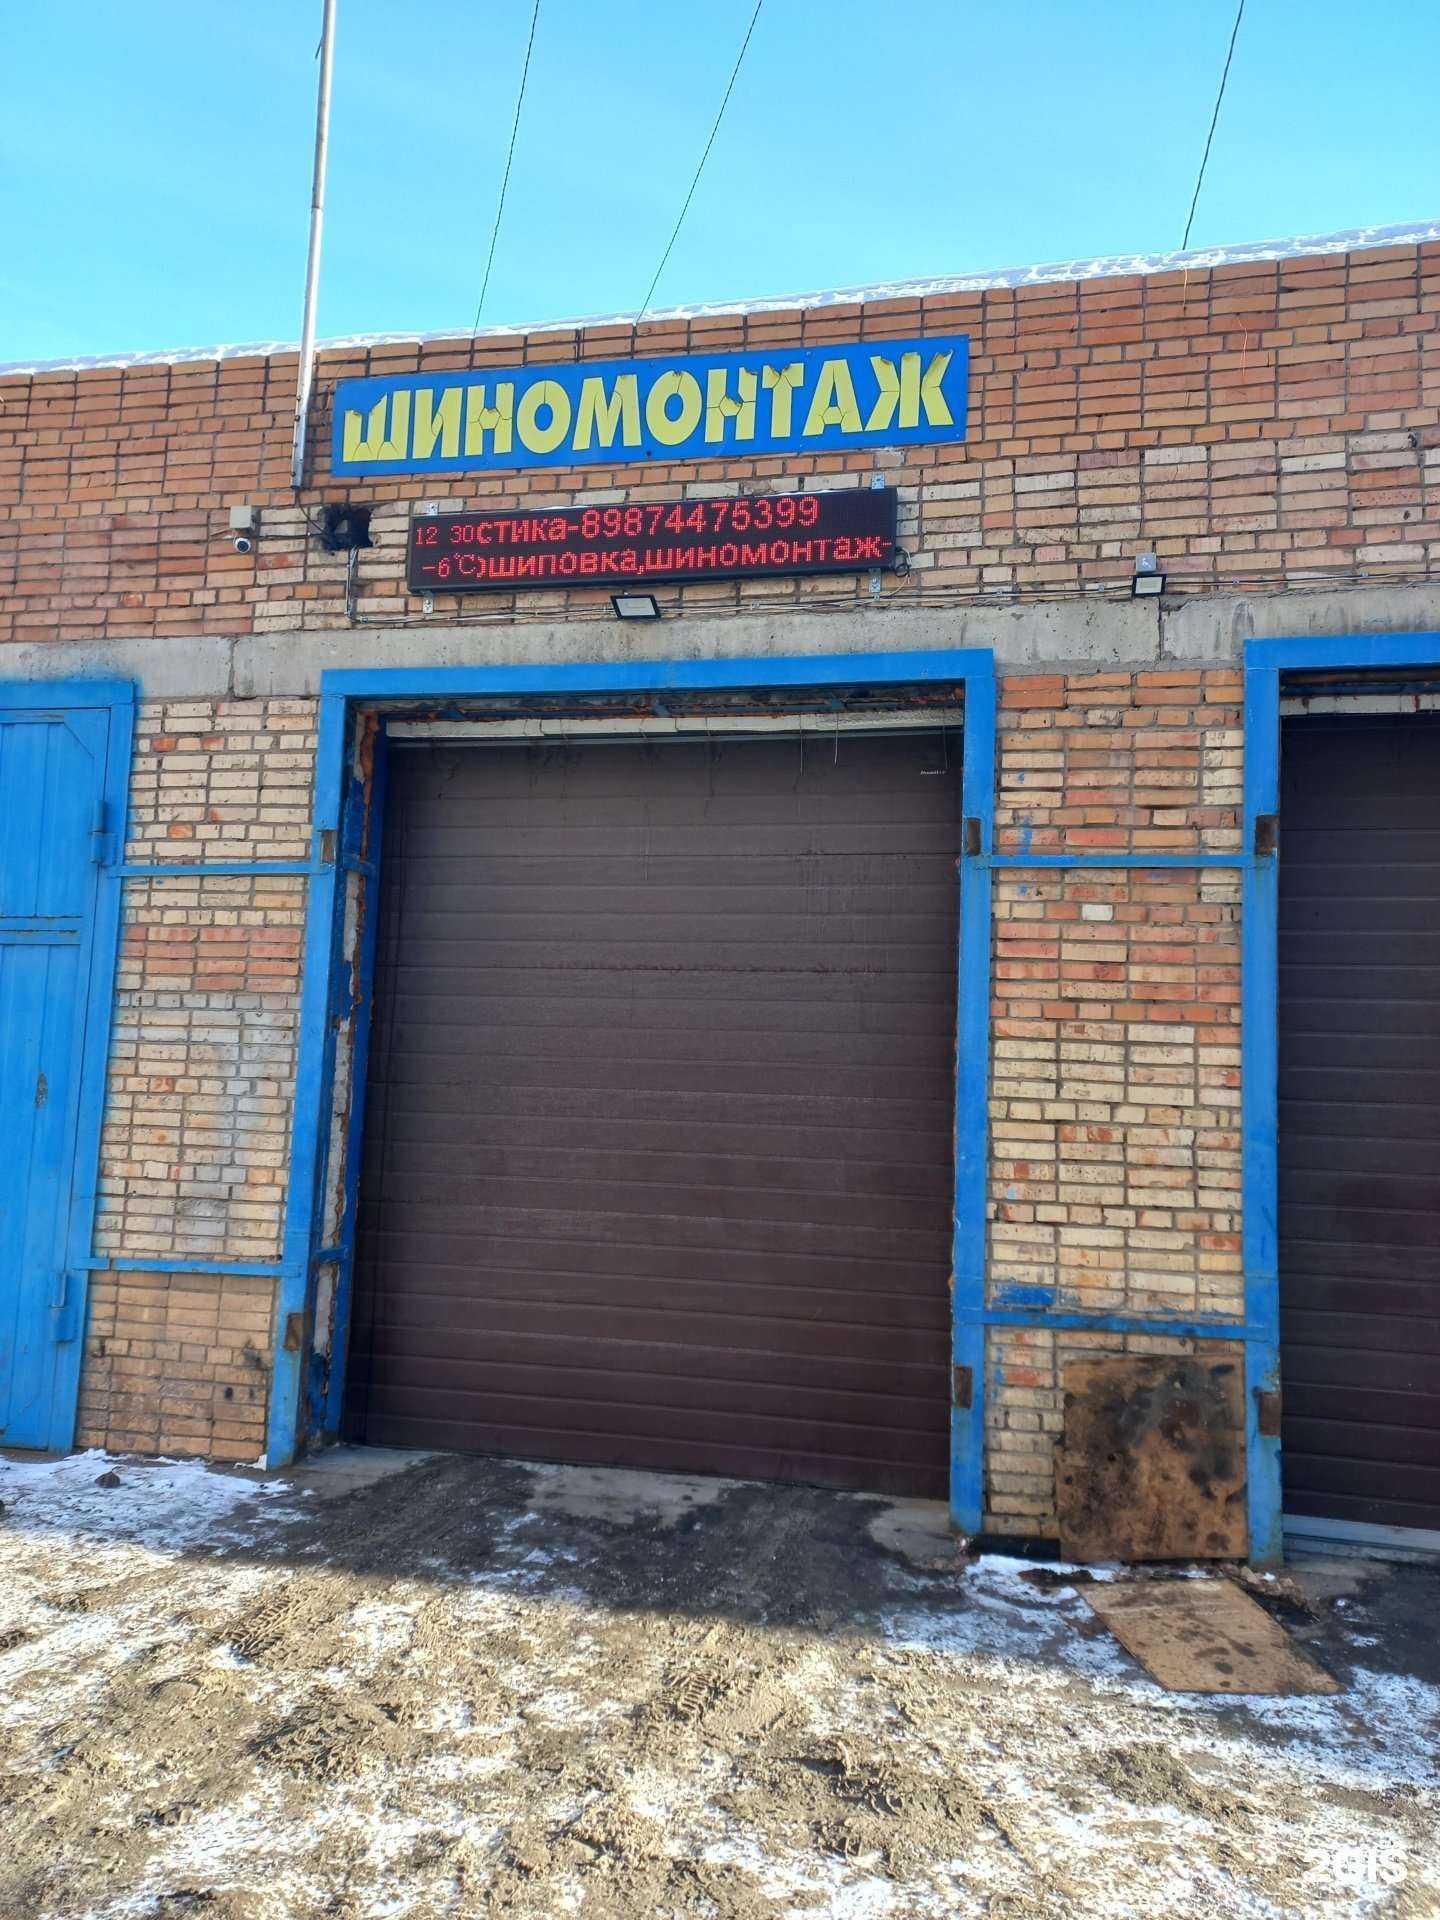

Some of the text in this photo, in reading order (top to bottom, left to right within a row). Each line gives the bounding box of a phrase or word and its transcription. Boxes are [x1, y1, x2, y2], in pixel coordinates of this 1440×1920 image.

[342, 349, 955, 463] ШИНОМОНТАЖ
[415, 526, 439, 545] 12
[450, 524, 474, 544] 30
